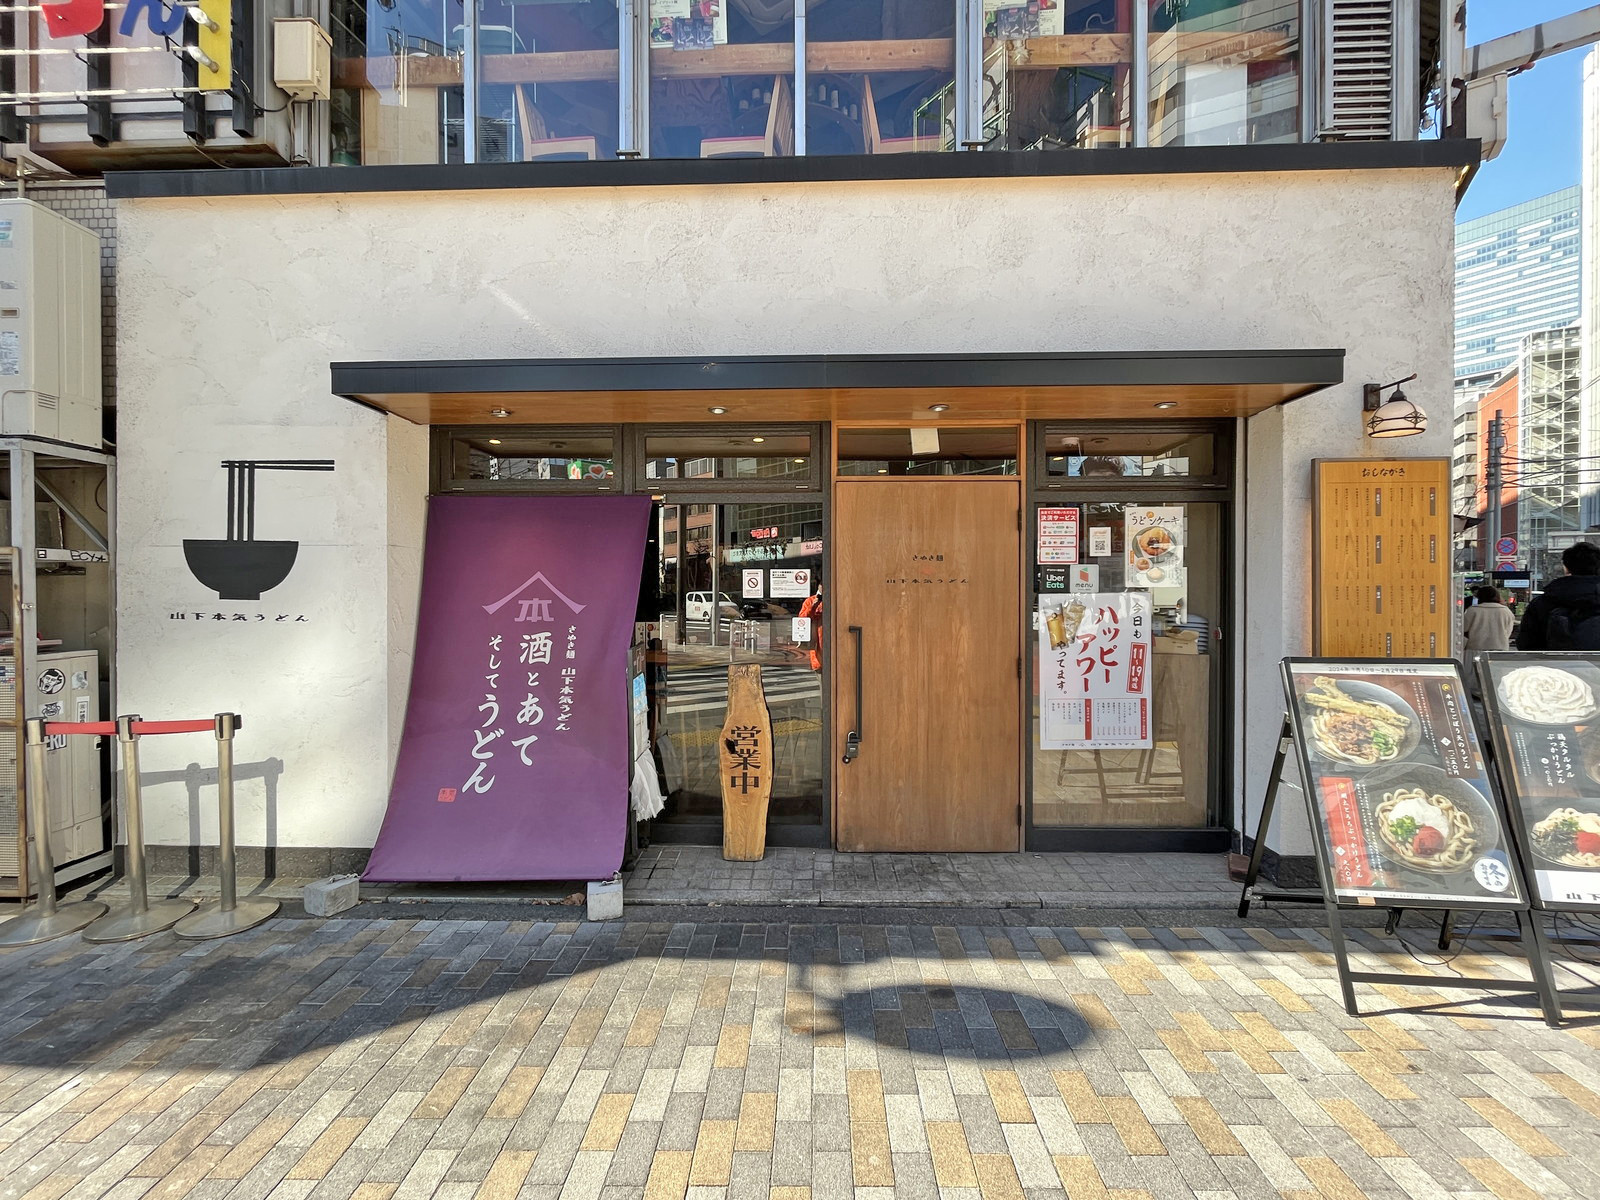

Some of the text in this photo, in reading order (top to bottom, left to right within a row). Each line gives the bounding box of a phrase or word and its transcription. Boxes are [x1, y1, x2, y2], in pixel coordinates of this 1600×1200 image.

[1362, 468, 1406, 477] おしながき
[170, 612, 309, 622] 山下本気うどん
[1095, 606, 1120, 684] ハッピー
[1132, 602, 1142, 639] 今日も
[1076, 634, 1096, 692] アワー
[462, 634, 504, 794] そしてうどん
[512, 632, 553, 766] 酒とあて
[555, 667, 576, 731] 山下本気うどん
[730, 726, 762, 794] 営業中
